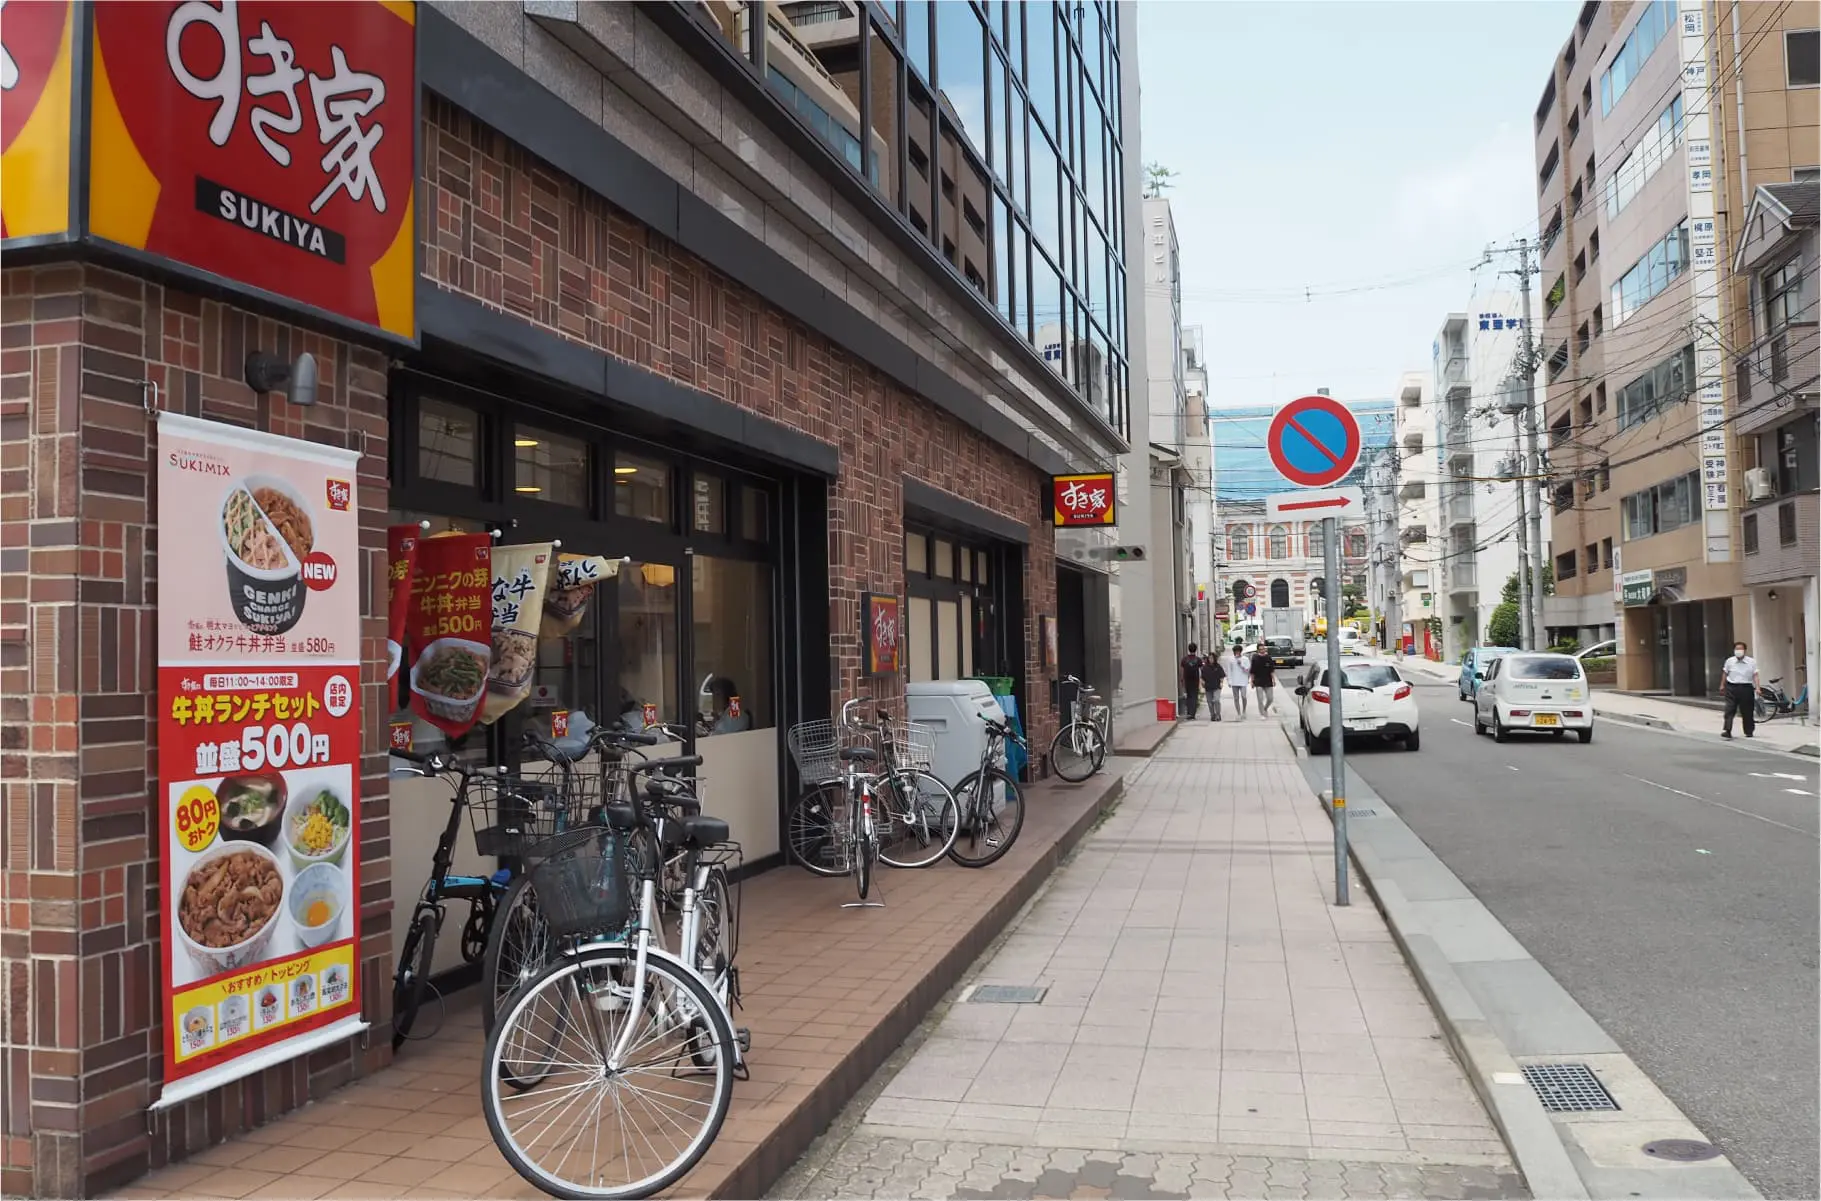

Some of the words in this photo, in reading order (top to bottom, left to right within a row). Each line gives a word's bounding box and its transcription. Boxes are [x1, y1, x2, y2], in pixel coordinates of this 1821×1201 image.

[166, 0, 387, 214] すき家
[219, 190, 327, 256] SUKIYA
[169, 453, 230, 476] SUKIMIX
[1061, 481, 1106, 512] すき家
[303, 563, 335, 580] NEW
[243, 584, 296, 605] GENKI
[875, 604, 895, 648] すき家
[189, 632, 286, 653] 鮭オクラ牛丼弁当
[330, 683, 346, 695] 店内
[172, 691, 320, 725] 牛丼ランチセット
[330, 696, 346, 708] 限定
[195, 722, 330, 775] 並盛500円
[177, 798, 217, 832] 80円
[188, 821, 215, 846] おトク
[271, 960, 310, 981] トッピング
